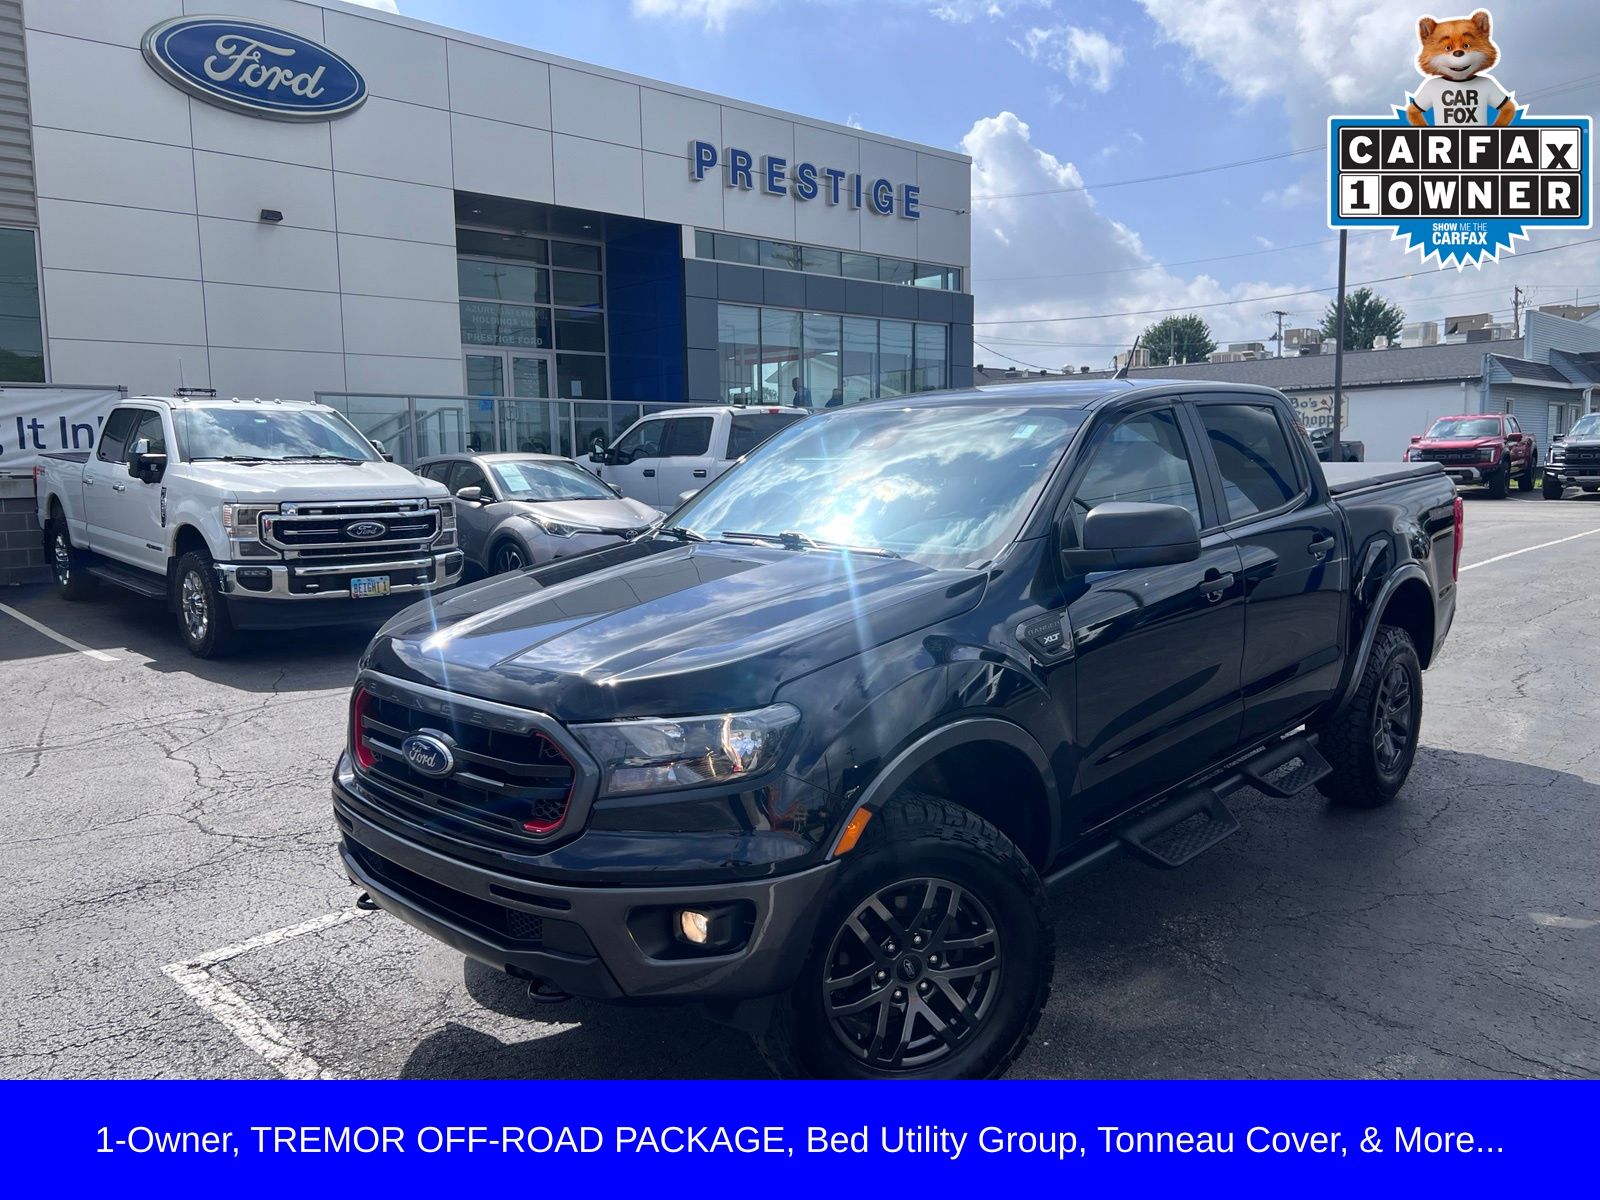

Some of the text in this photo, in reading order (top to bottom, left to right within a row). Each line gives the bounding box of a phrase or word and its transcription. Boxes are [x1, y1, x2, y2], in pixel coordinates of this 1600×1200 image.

[204, 34, 326, 99] Ford
[690, 139, 921, 220] PRESTIGE
[466, 332, 543, 345] PRESTIGE FORD
[16, 416, 46, 449] It
[356, 525, 378, 535] Ford
[1043, 632, 1060, 644] XLT
[409, 741, 437, 767] Ford
